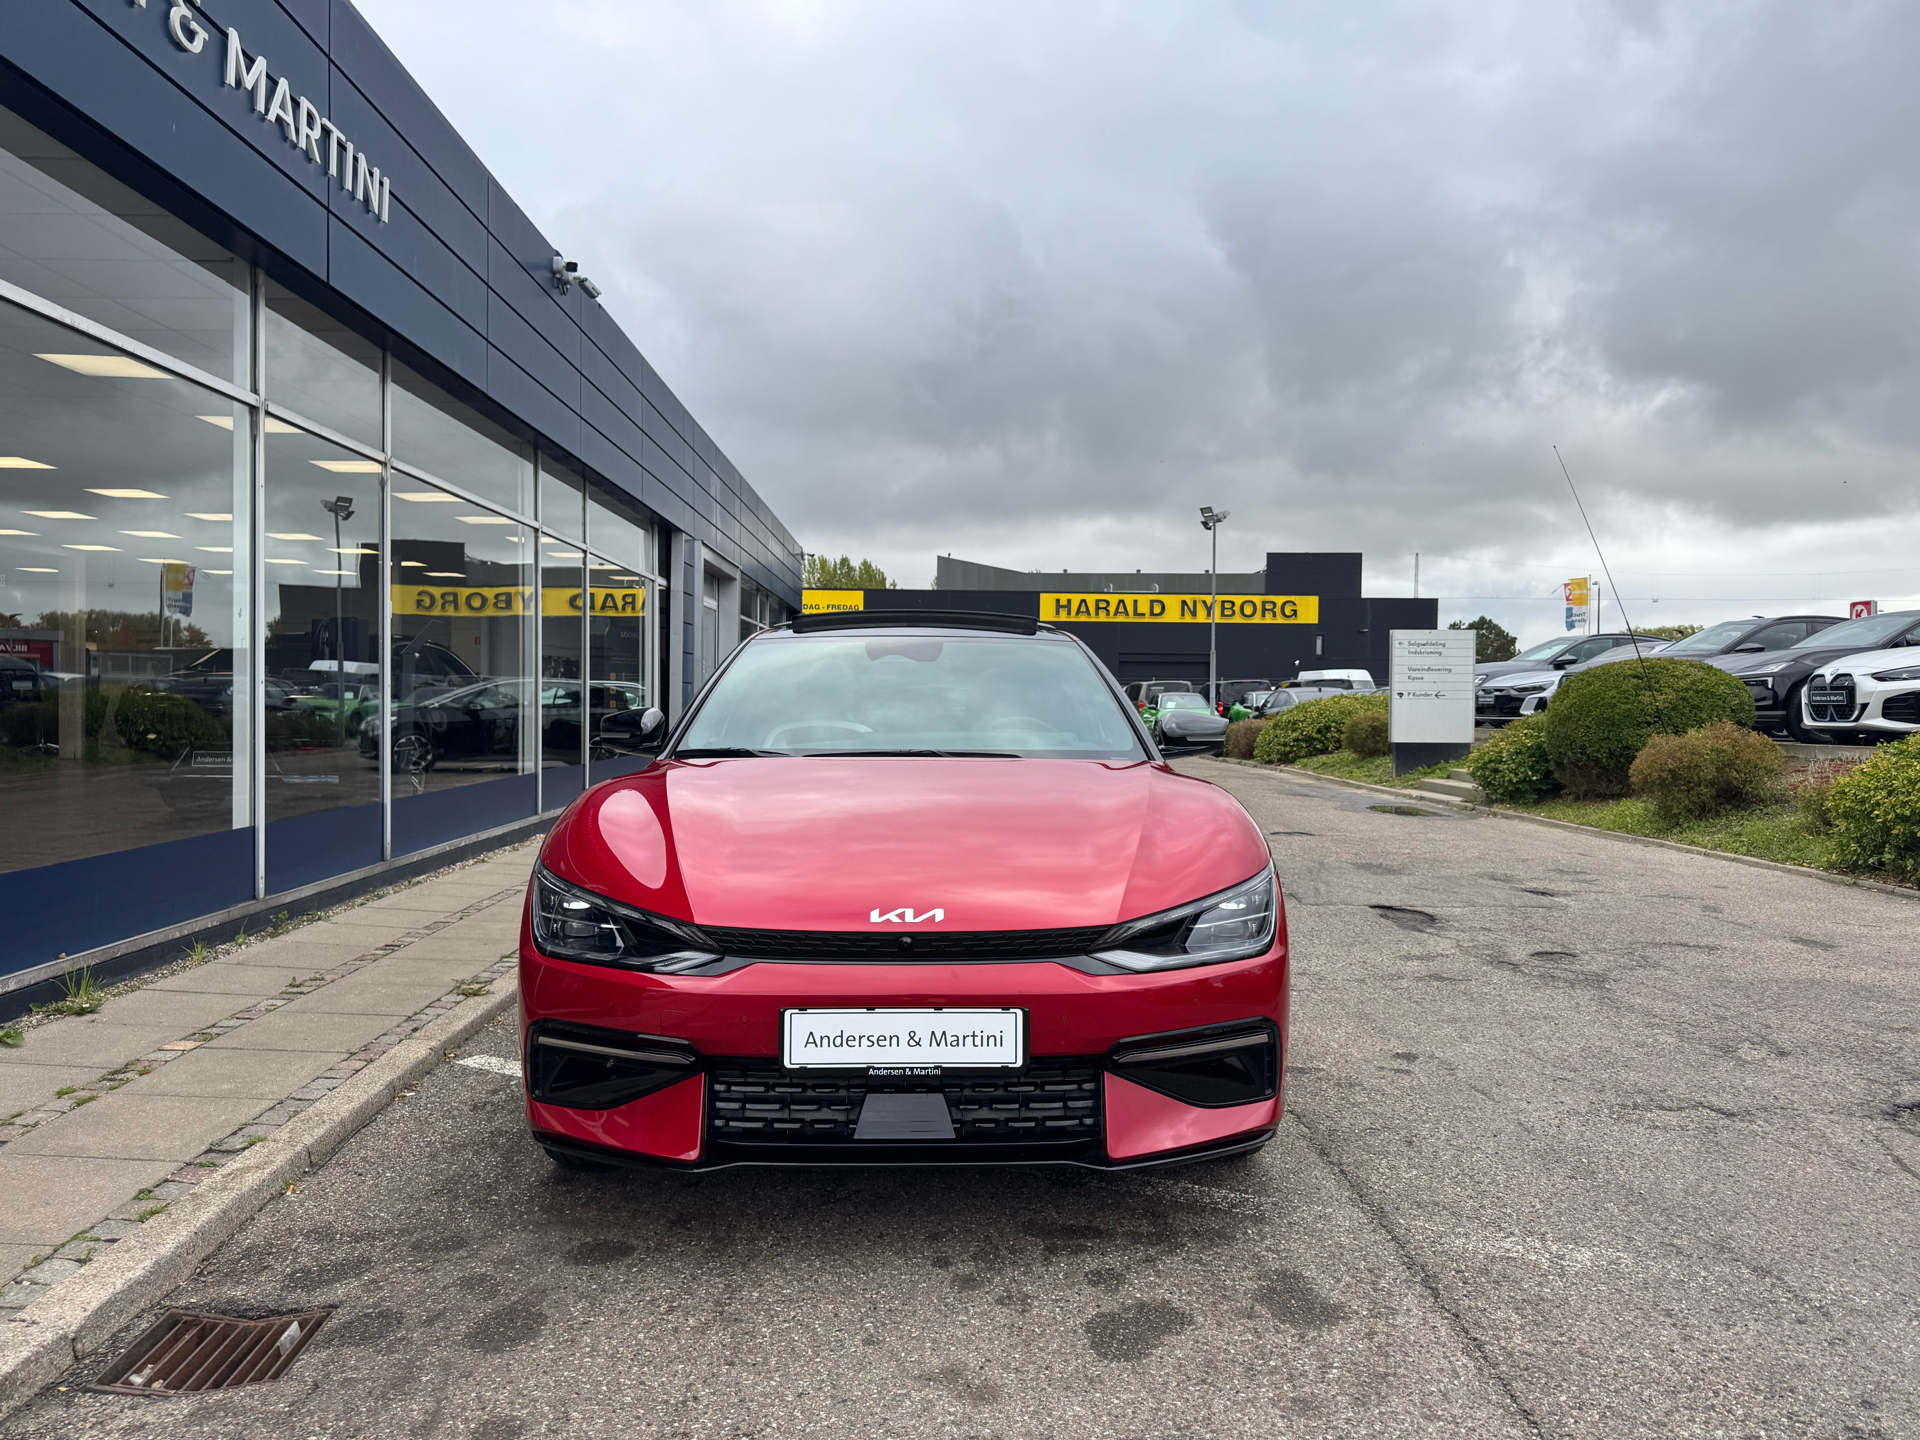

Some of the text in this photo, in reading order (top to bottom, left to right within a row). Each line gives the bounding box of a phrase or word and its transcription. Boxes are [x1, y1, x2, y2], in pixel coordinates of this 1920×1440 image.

[223, 27, 390, 224] MARTINI
[1054, 598, 1299, 619] HARALD NYBORG
[869, 908, 944, 923] KIA
[803, 1029, 1004, 1048] Andersen & Martini
[868, 1067, 941, 1076] Andersen & Martini
